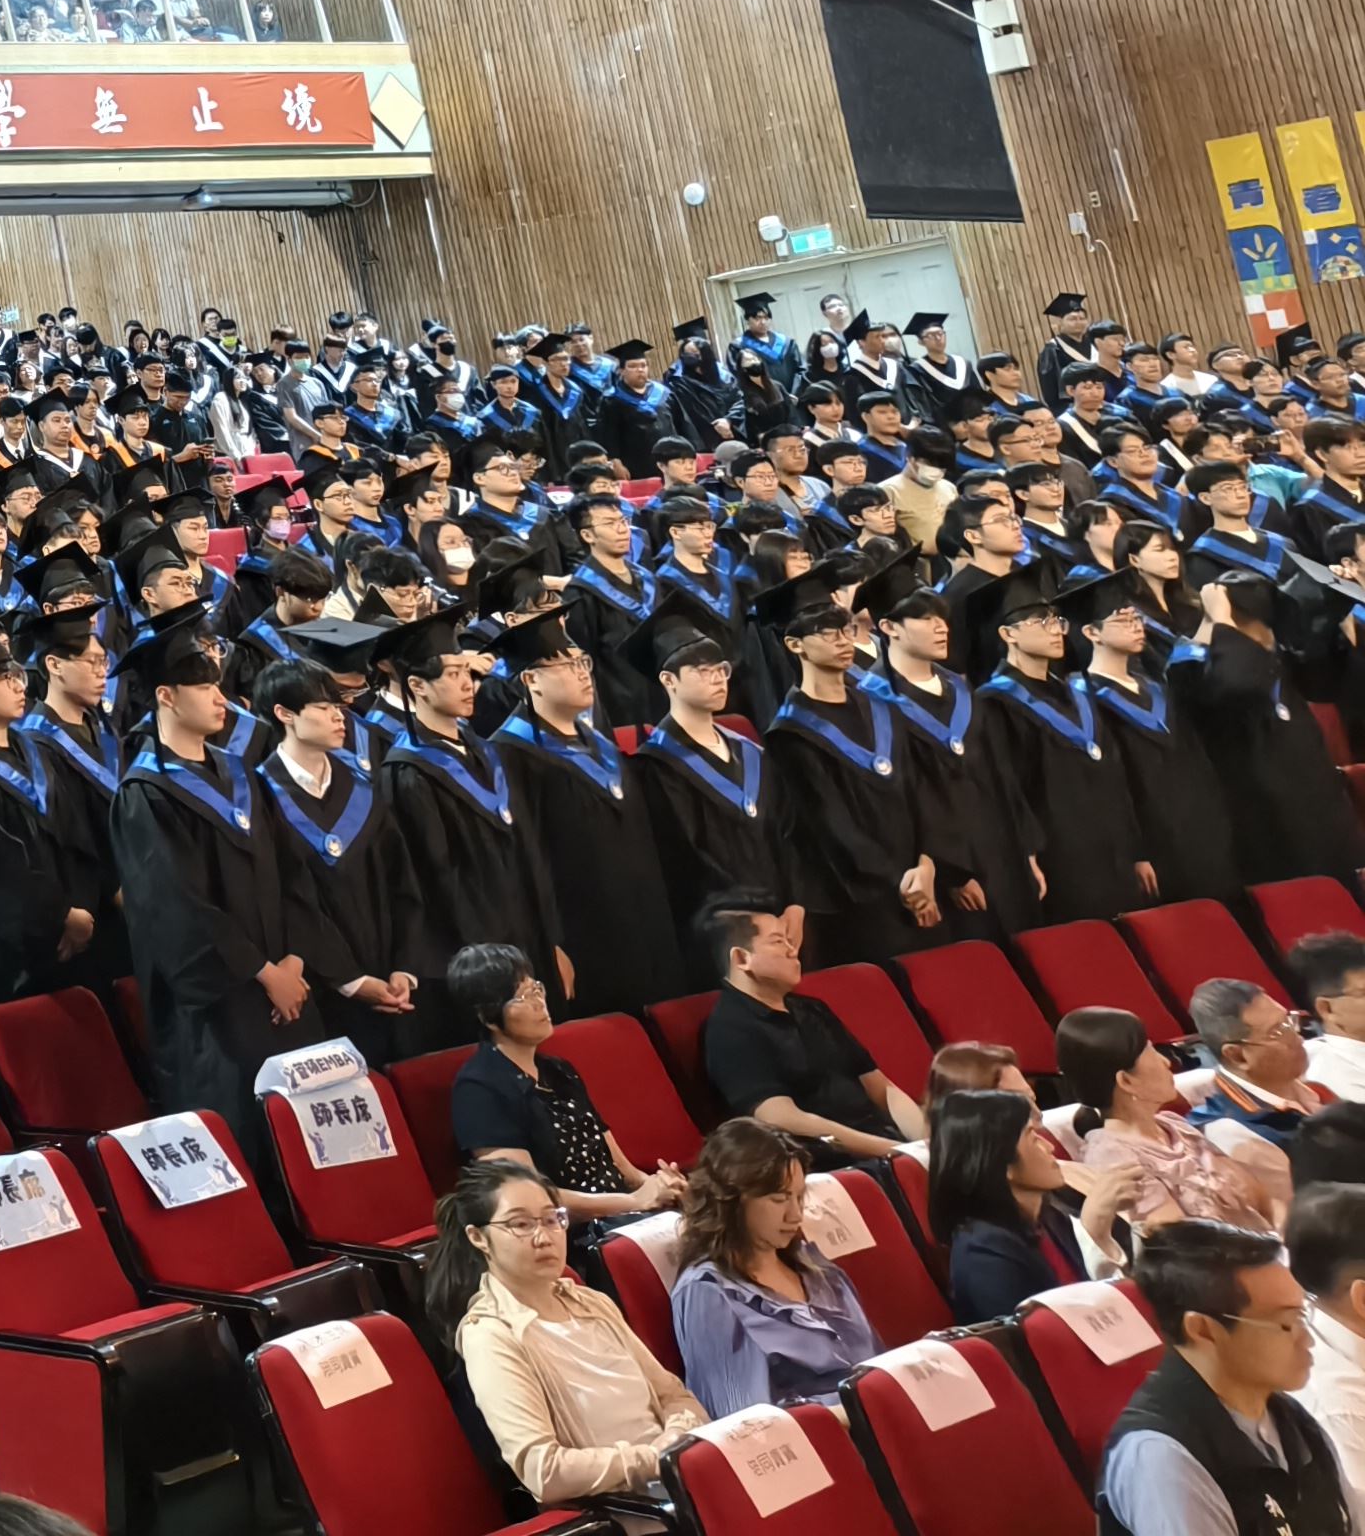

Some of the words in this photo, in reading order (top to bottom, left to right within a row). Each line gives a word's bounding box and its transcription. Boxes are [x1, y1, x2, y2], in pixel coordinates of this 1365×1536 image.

[309, 1095, 372, 1128] 師長席
[140, 1136, 208, 1172] 師長席
